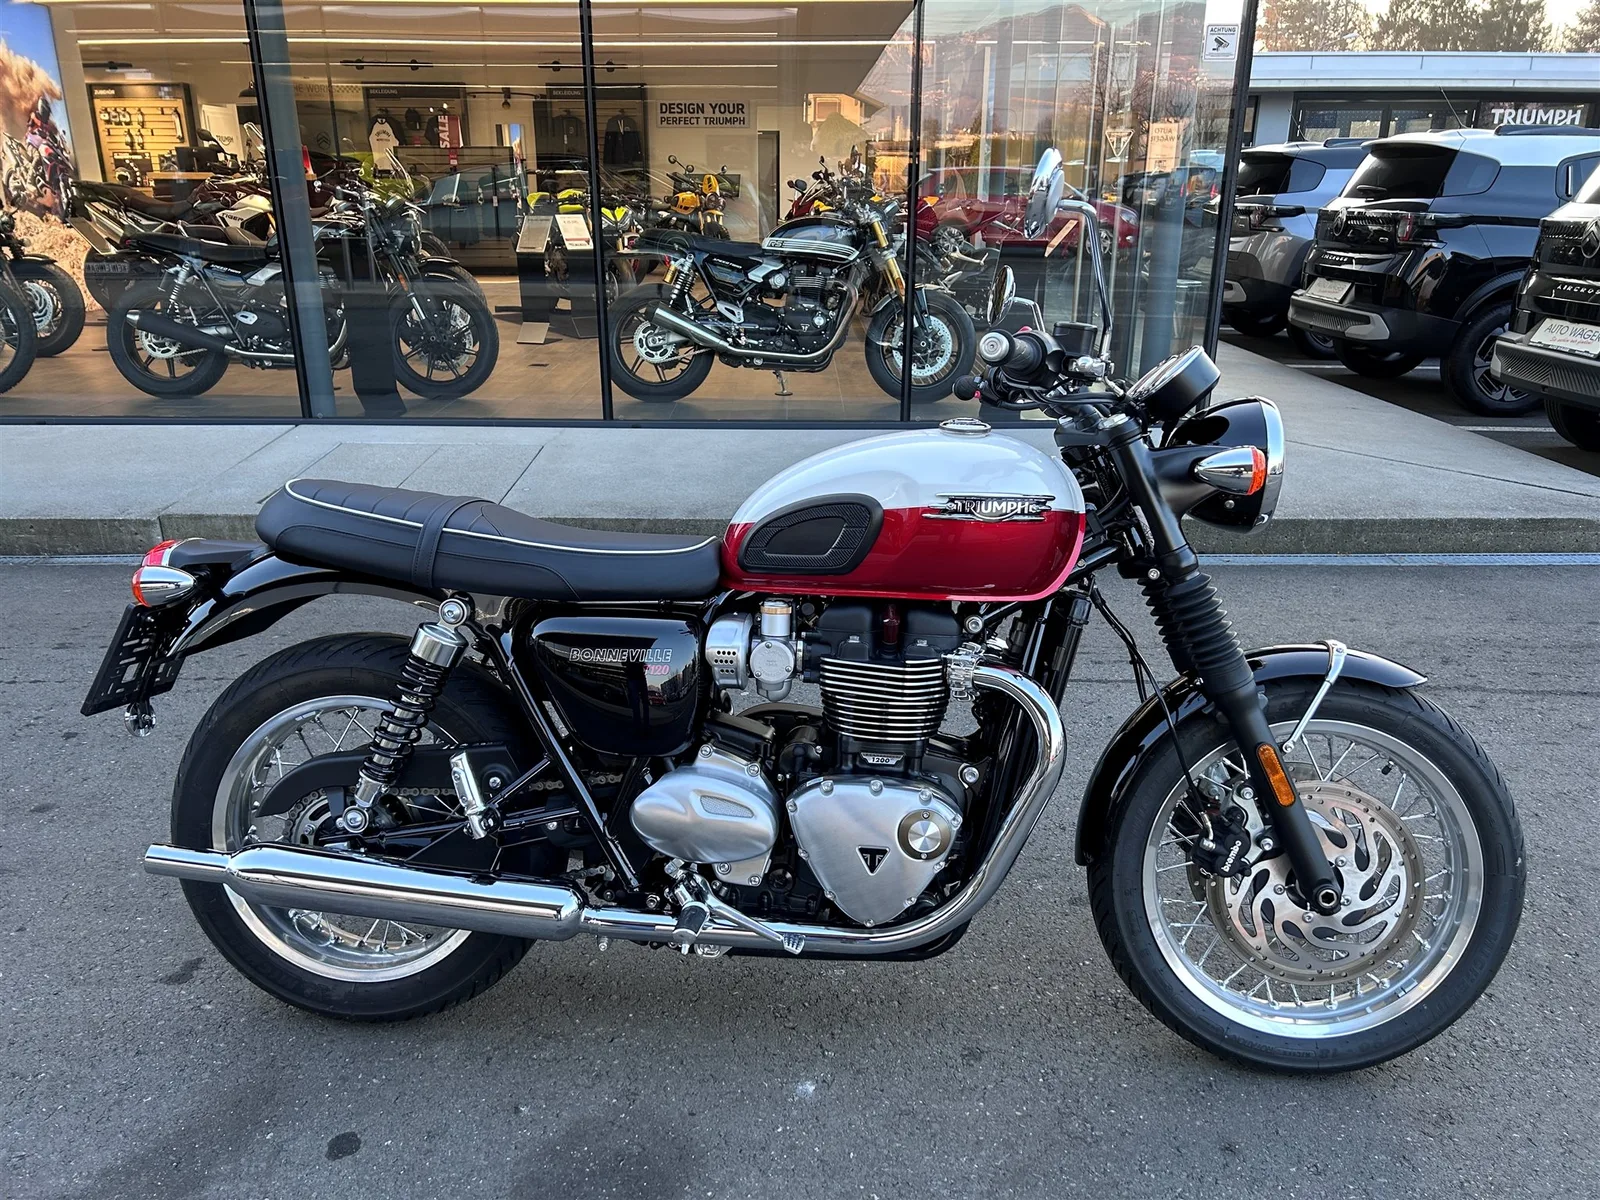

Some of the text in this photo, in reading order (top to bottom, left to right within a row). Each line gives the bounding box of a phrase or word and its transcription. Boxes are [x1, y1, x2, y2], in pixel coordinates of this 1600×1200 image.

[660, 103, 745, 115] DESIGN YOUR
[660, 116, 746, 126] PERFECT TRIUMPH
[1491, 108, 1582, 126] TRIUMPH
[438, 115, 450, 149] SALE
[221, 213, 245, 222] TIGER
[1544, 323, 1569, 336] AUTO
[953, 500, 1030, 517] TRIUMPH
[569, 648, 673, 662] BONNEVILLE
[643, 664, 670, 675] T120
[1221, 840, 1242, 873] brembo
